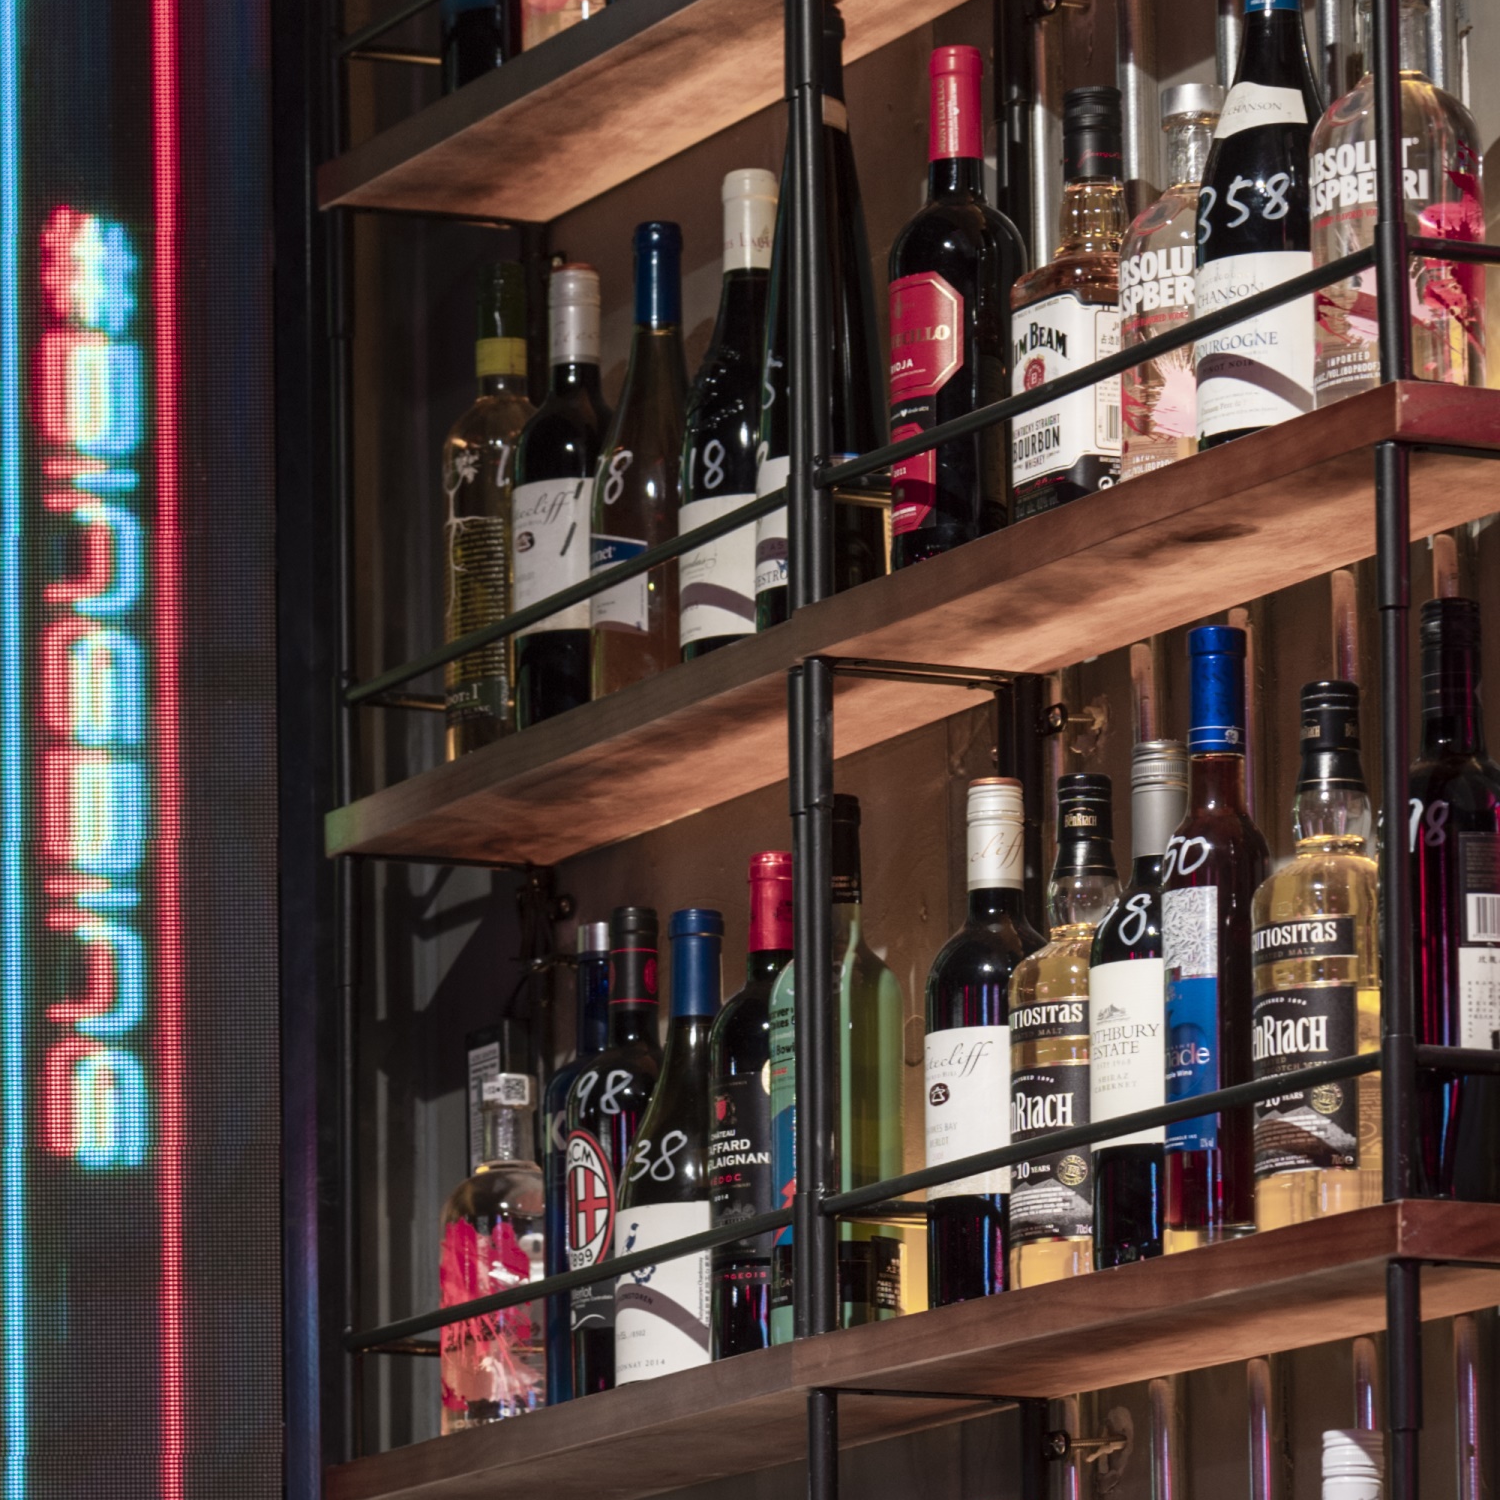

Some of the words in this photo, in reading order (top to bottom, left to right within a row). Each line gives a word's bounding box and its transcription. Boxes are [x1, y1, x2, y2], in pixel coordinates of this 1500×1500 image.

[1310, 137, 1414, 188] ABSOLT
[1310, 169, 1428, 216] ASPBERI
[1029, 321, 1067, 359] BEAM
[1013, 425, 1060, 463] BOURBON
[1093, 1041, 1140, 1062] ESTATE
